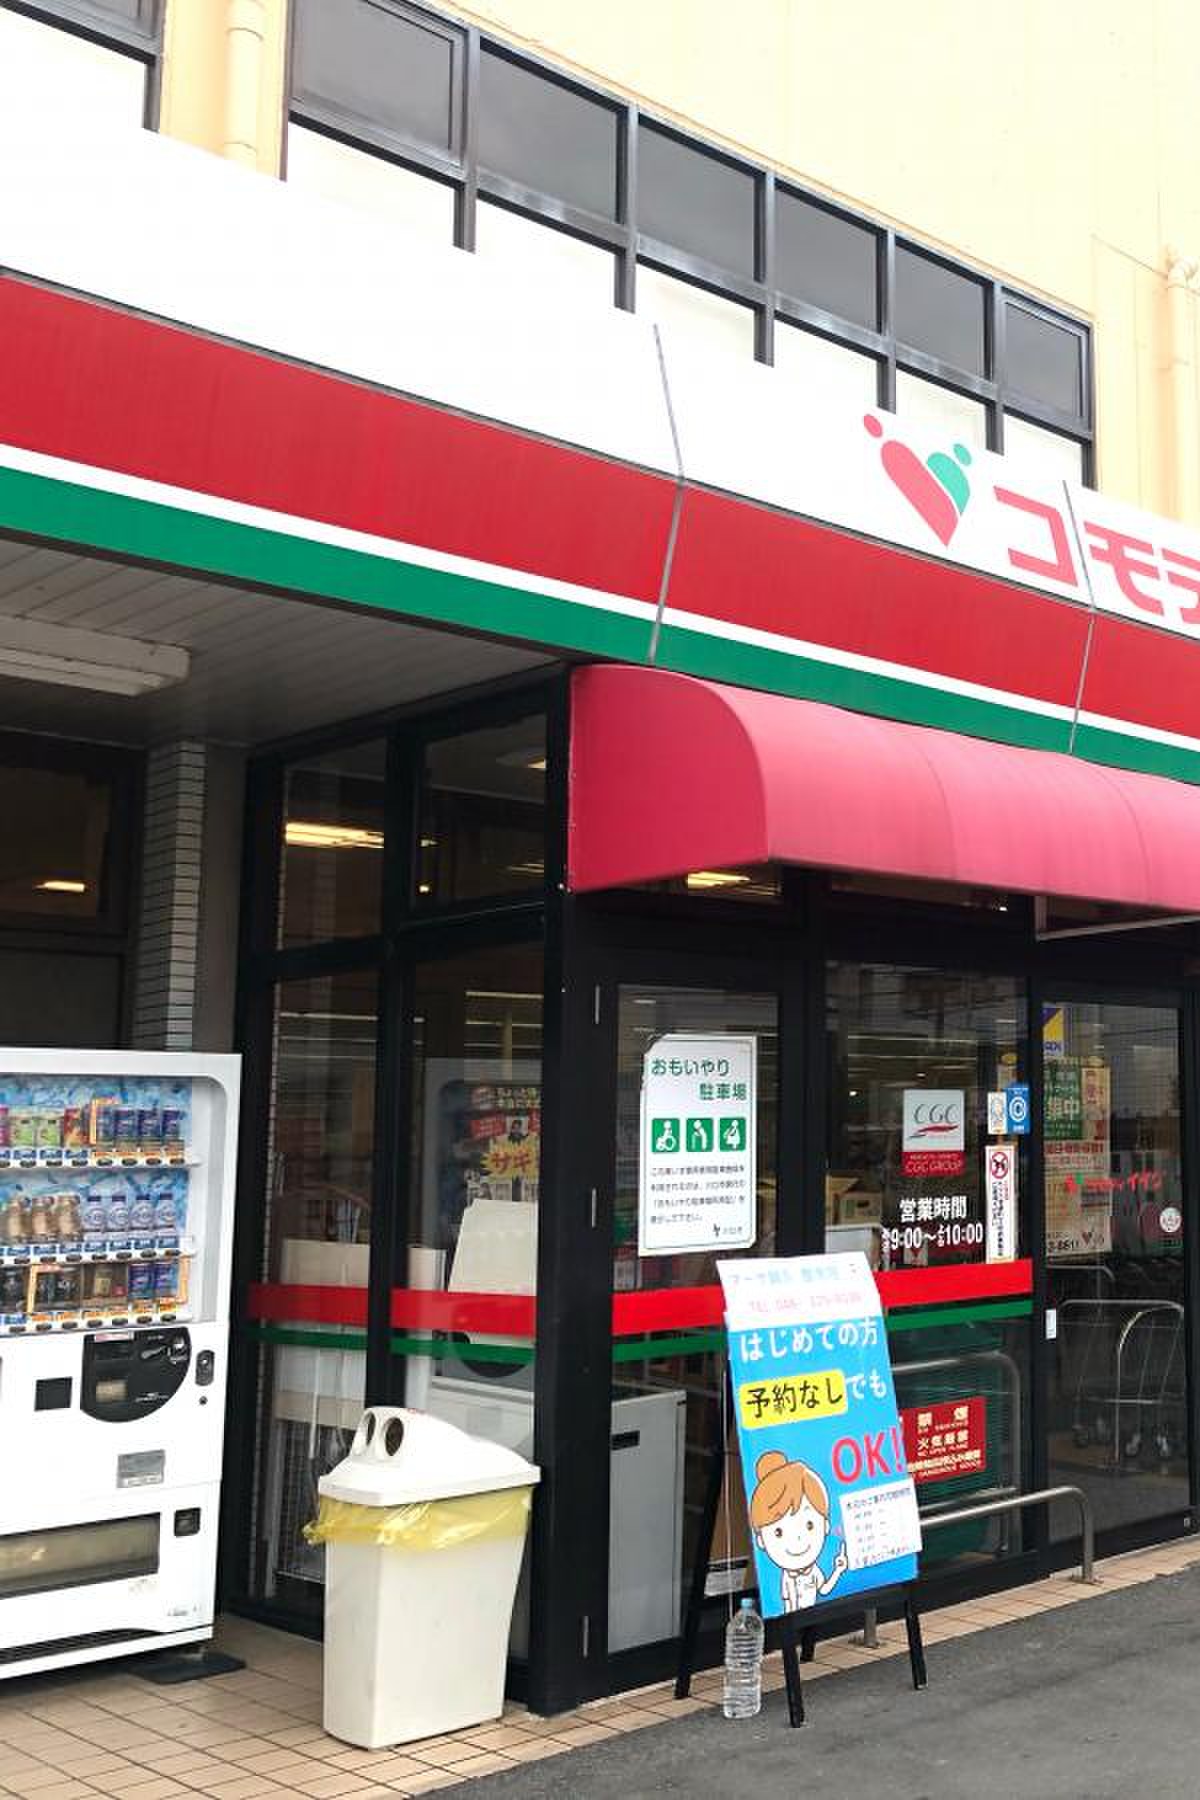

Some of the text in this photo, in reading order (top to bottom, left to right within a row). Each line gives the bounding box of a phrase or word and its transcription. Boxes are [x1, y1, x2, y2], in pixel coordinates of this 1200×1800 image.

[651, 1058, 730, 1077] おもいやり
[699, 1082, 748, 1101] 駐車場
[900, 1196, 967, 1223] 営業時間
[740, 1316, 878, 1363] はじめての方
[832, 1426, 904, 1485] OK!
